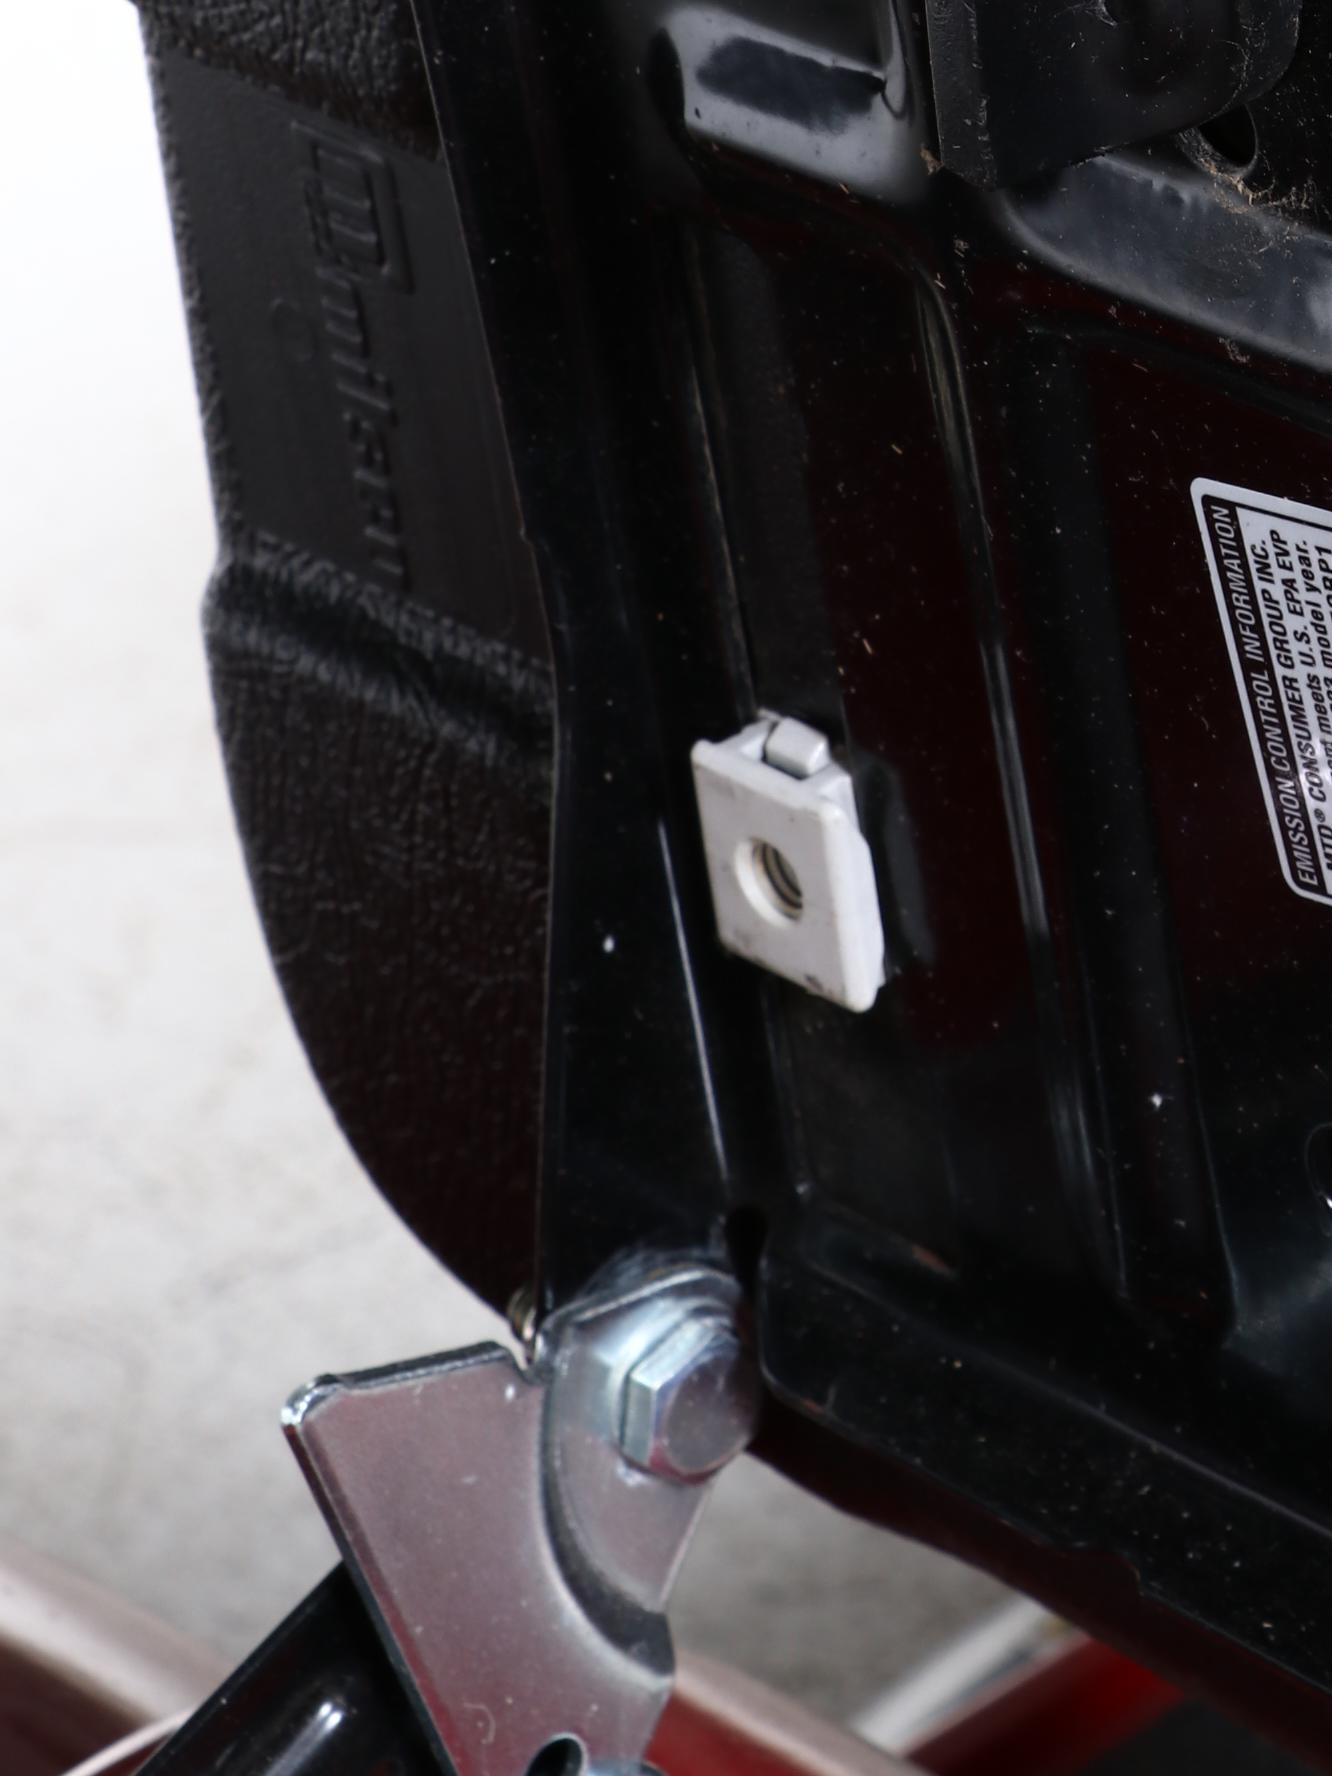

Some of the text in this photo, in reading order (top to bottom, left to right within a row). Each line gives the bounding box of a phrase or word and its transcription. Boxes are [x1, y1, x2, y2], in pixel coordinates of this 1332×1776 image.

[1251, 541, 1275, 584] INC.
[1270, 530, 1294, 572] EVP
[1295, 541, 1322, 594] year.
[1281, 578, 1304, 617] EPA
[1261, 589, 1295, 669] GROUP
[1293, 626, 1316, 667] U.S.
[1211, 506, 1318, 885] EMISSION CONTROL INFORMATION
[1306, 673, 1332, 735] meets
[1282, 675, 1326, 802] CONSUMER
